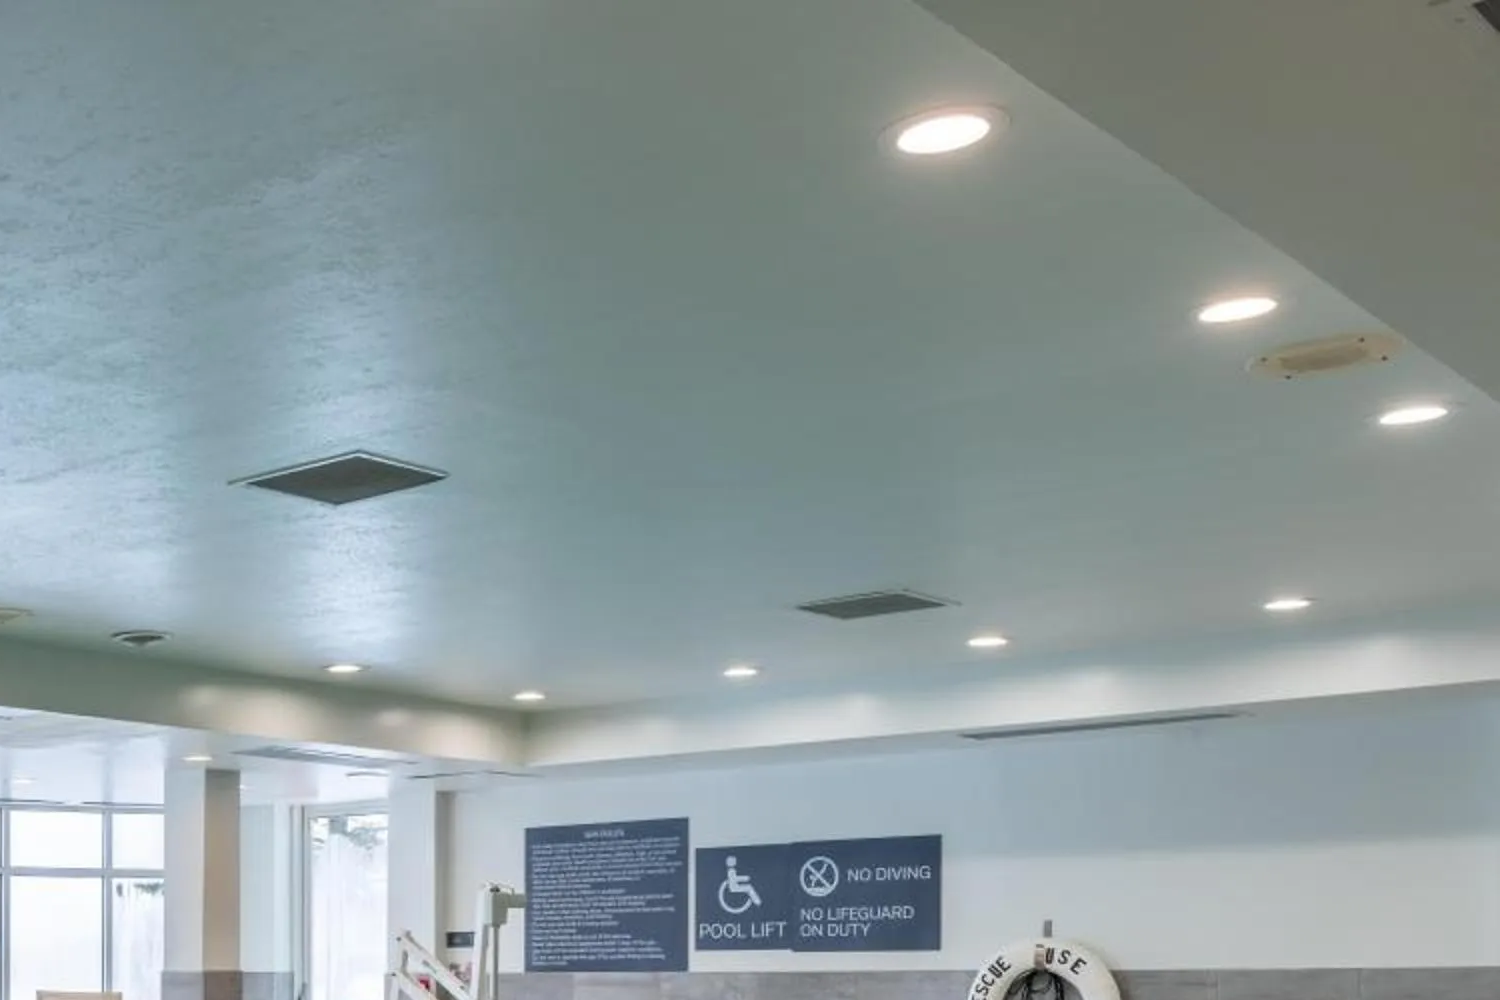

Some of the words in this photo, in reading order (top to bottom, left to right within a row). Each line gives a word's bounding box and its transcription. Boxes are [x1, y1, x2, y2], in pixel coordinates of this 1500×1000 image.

[847, 867, 872, 882] NO
[875, 864, 931, 881] DIVING
[800, 906, 824, 921] NO
[827, 905, 915, 921] LIFEGUARD
[699, 922, 746, 939] POOL
[751, 921, 787, 938] LIFT
[800, 922, 824, 937] ON
[827, 922, 871, 937] DUTY
[1044, 946, 1088, 975] USE
